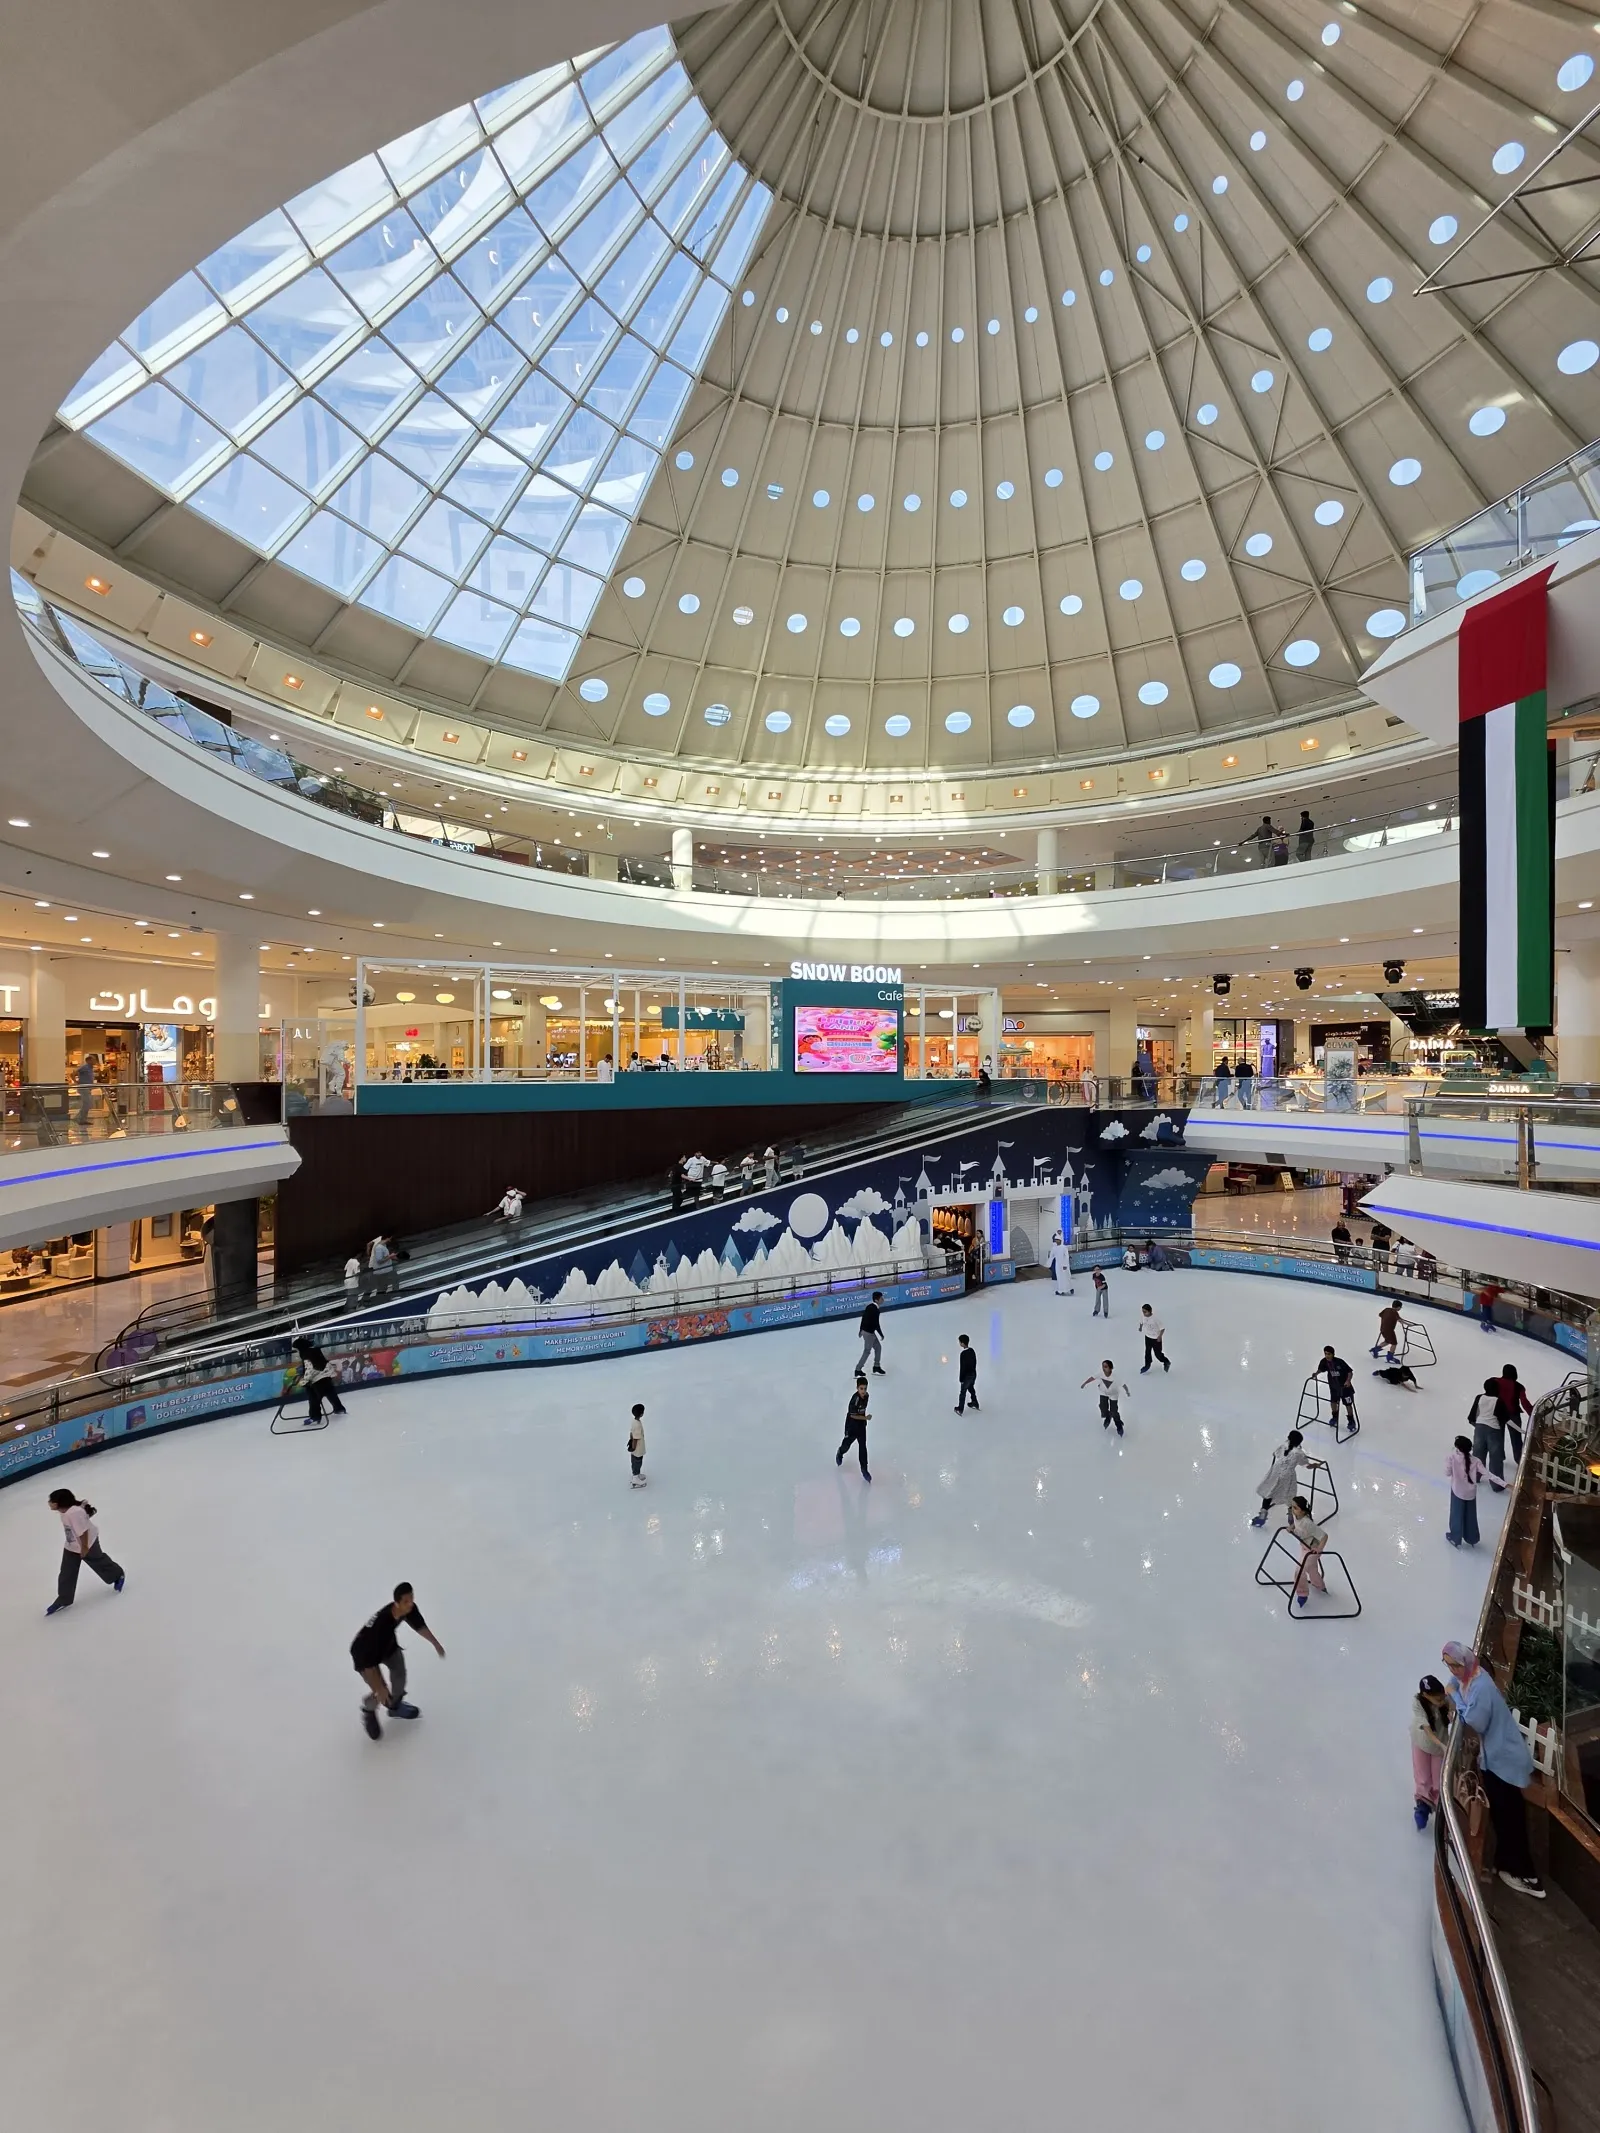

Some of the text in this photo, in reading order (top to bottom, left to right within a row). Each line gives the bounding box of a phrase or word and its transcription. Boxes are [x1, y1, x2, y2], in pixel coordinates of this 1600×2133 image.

[790, 962, 901, 984] SNOW BOOM
[877, 990, 903, 1001] Cafe
[1409, 1039, 1455, 1050] DAIMA
[1488, 1084, 1530, 1093] DAIMA
[911, 1290, 926, 1298] LEVEL
[544, 1338, 562, 1346] MAKE
[580, 1335, 598, 1343] THEIR
[598, 1331, 627, 1340] FAVORITE
[599, 1341, 616, 1349] YEAR
[150, 1382, 254, 1411] THE BEST BIRTHDAY GIFT
[156, 1405, 195, 1420] DOESN'T
[196, 1402, 209, 1410] FIT
[228, 1394, 245, 1403] BOX
[35, 1440, 60, 1456] تجربة
